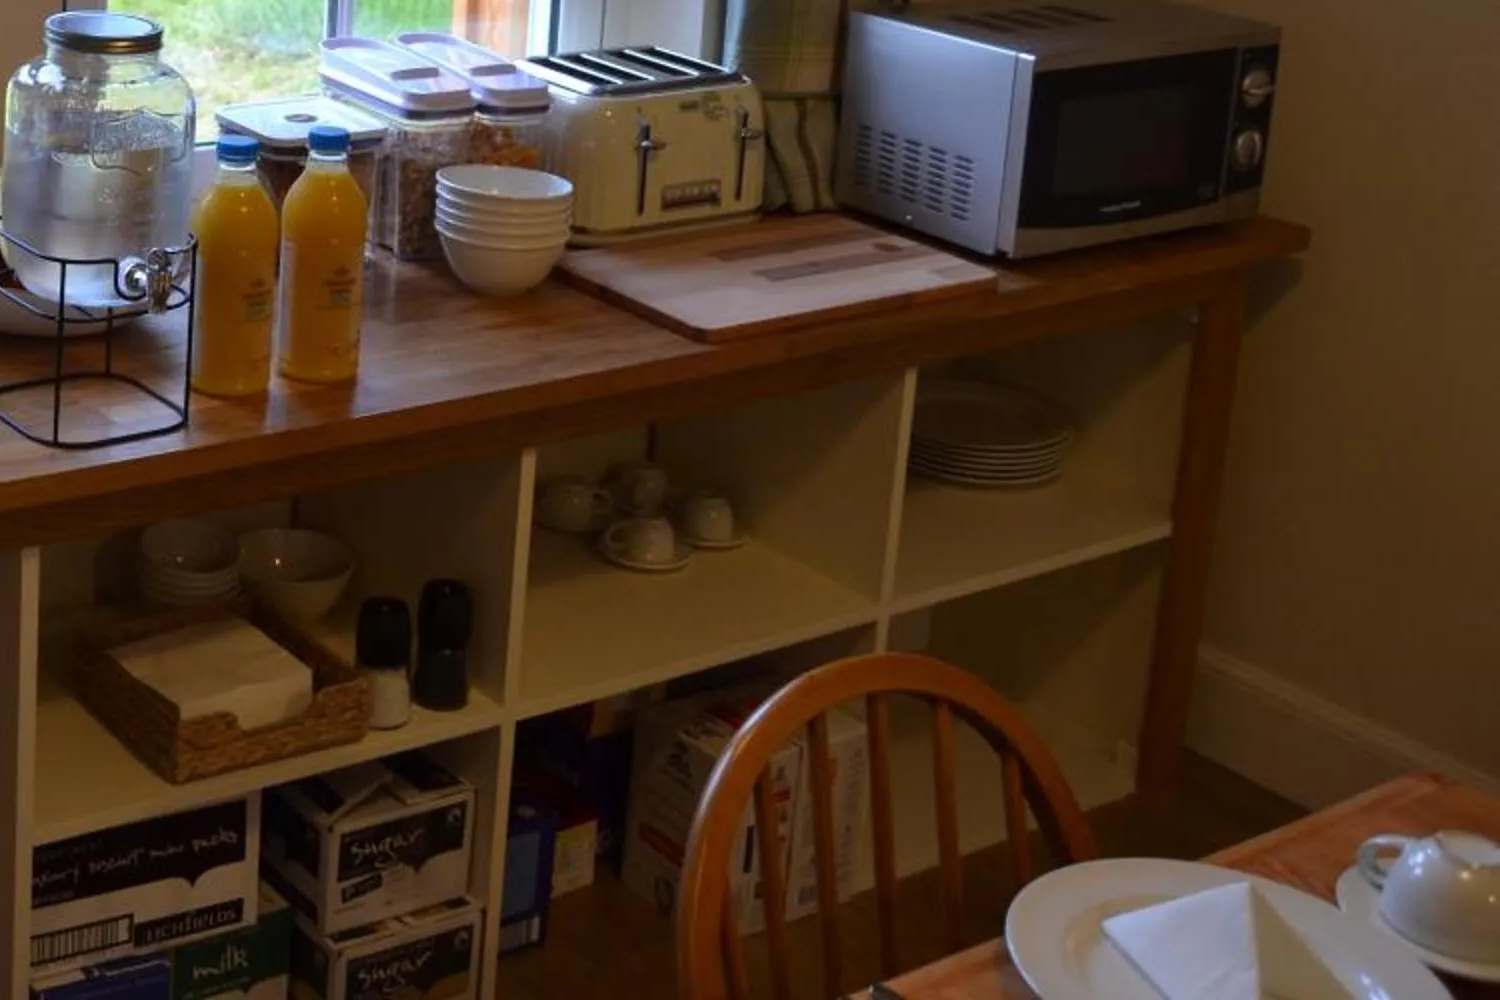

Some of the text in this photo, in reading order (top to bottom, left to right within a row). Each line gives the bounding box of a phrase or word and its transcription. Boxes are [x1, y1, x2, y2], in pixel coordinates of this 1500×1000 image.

[350, 826, 425, 868] sugar
[192, 943, 250, 980] milk
[357, 950, 432, 993] sugar
